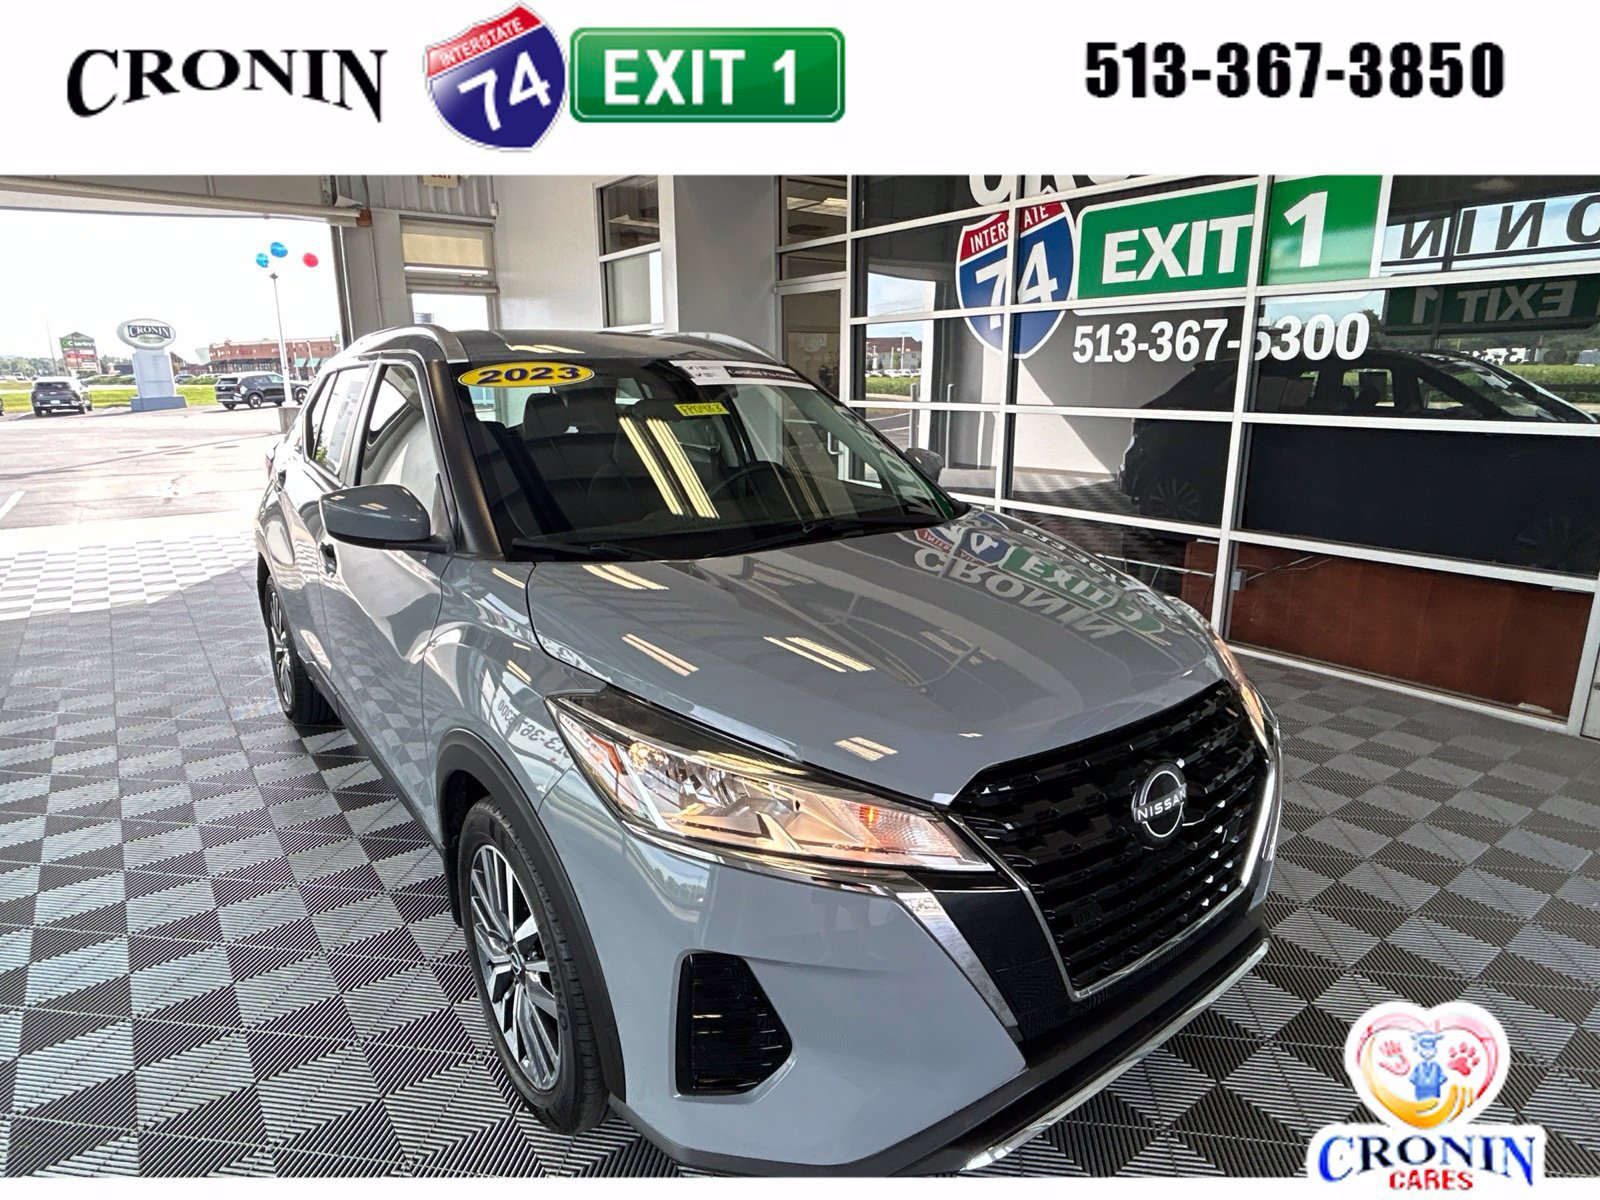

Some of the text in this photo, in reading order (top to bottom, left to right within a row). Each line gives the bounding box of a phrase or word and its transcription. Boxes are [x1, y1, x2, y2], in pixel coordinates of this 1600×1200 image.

[969, 205, 1049, 253] INTERATE
[1102, 190, 1329, 285] EXIT 1
[975, 241, 1058, 330] 74
[128, 325, 170, 338] CRONIN
[477, 367, 581, 384] 2023
[1137, 783, 1187, 821] NISSAN
